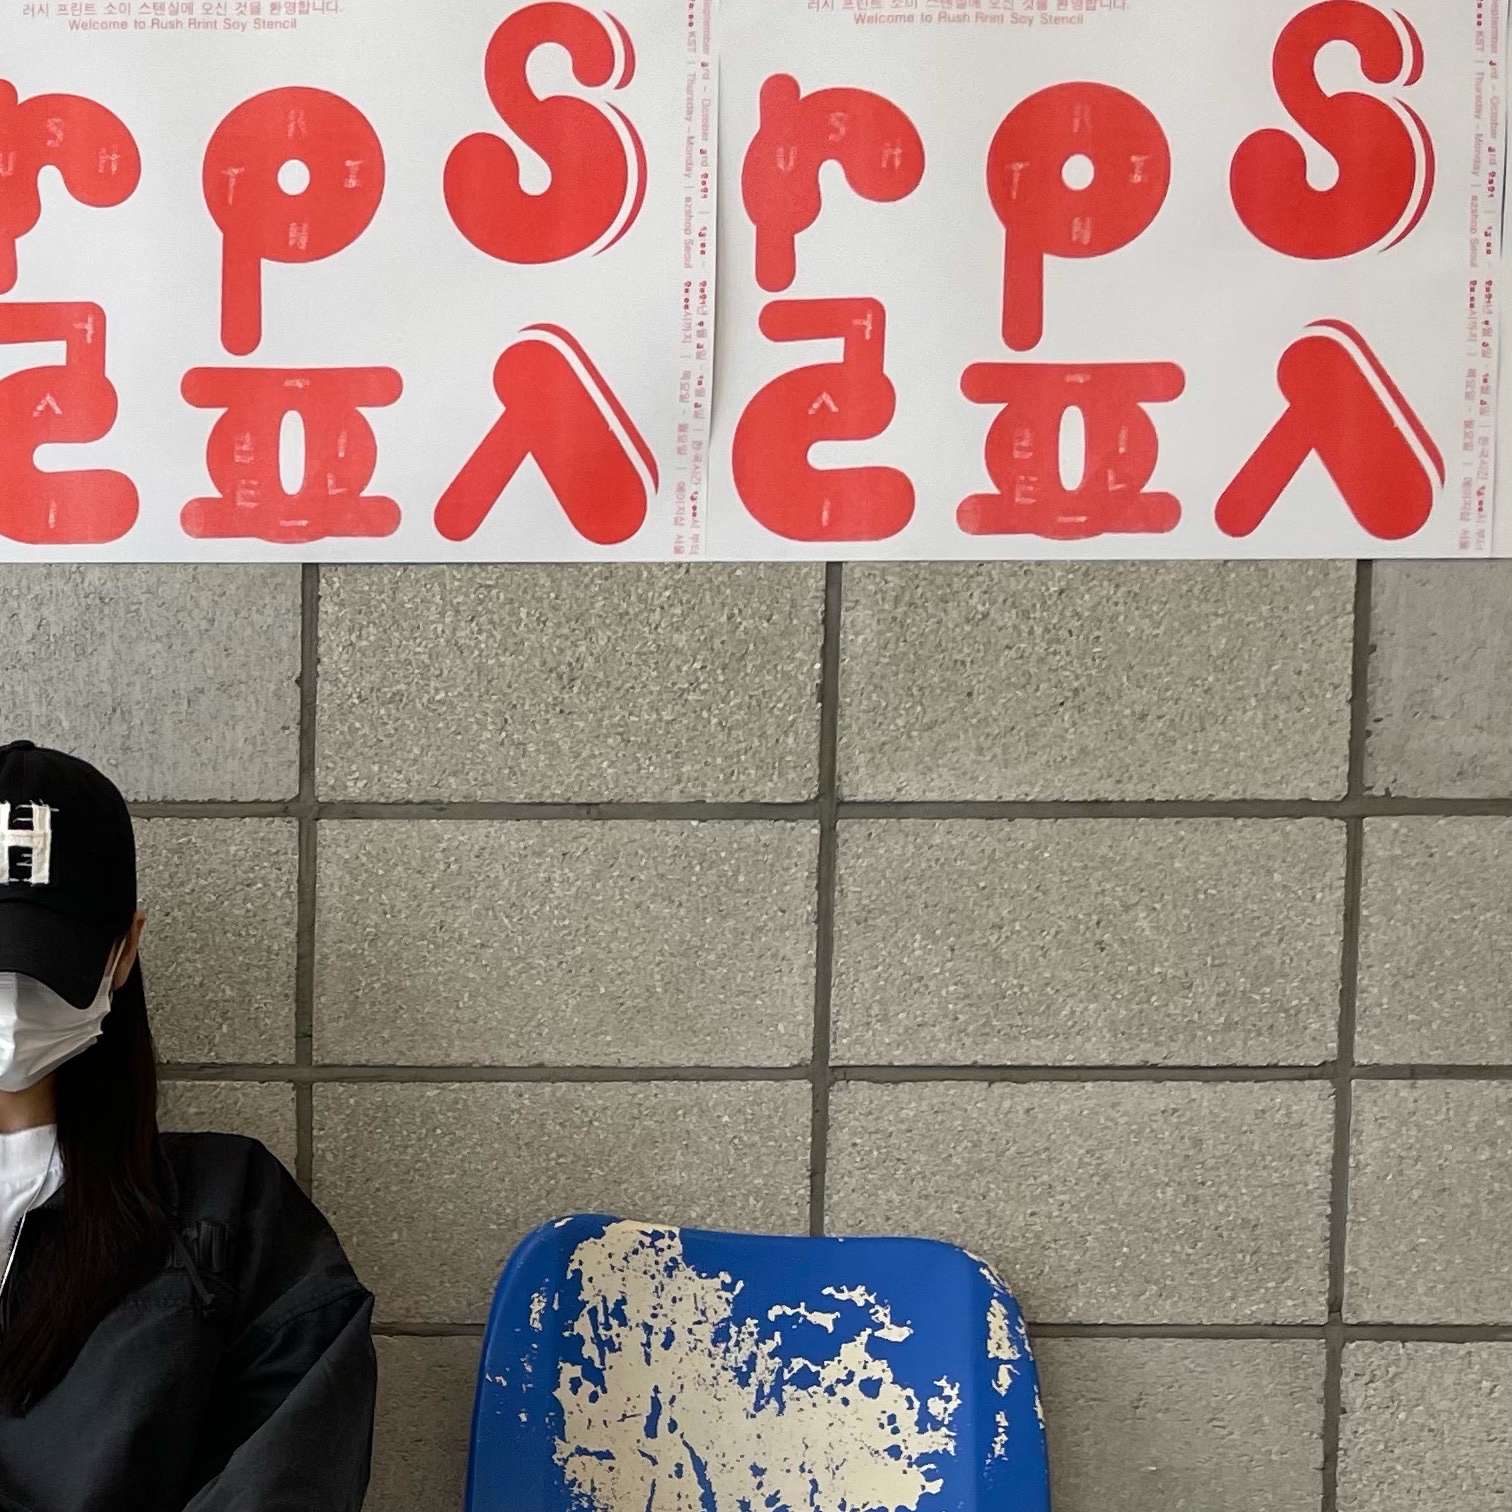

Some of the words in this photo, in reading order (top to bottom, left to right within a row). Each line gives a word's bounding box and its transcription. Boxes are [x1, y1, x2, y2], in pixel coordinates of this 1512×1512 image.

[68, 18, 128, 30] Welcome
[133, 19, 146, 30] to
[151, 18, 183, 30] Rush
[223, 18, 247, 32] Soy
[253, 18, 297, 29] Stencil
[853, 13, 914, 25] Welcome
[920, 13, 932, 24] to
[938, 12, 970, 24] Rush
[1010, 12, 1034, 27] Soy
[1040, 12, 1084, 24] Stencil
